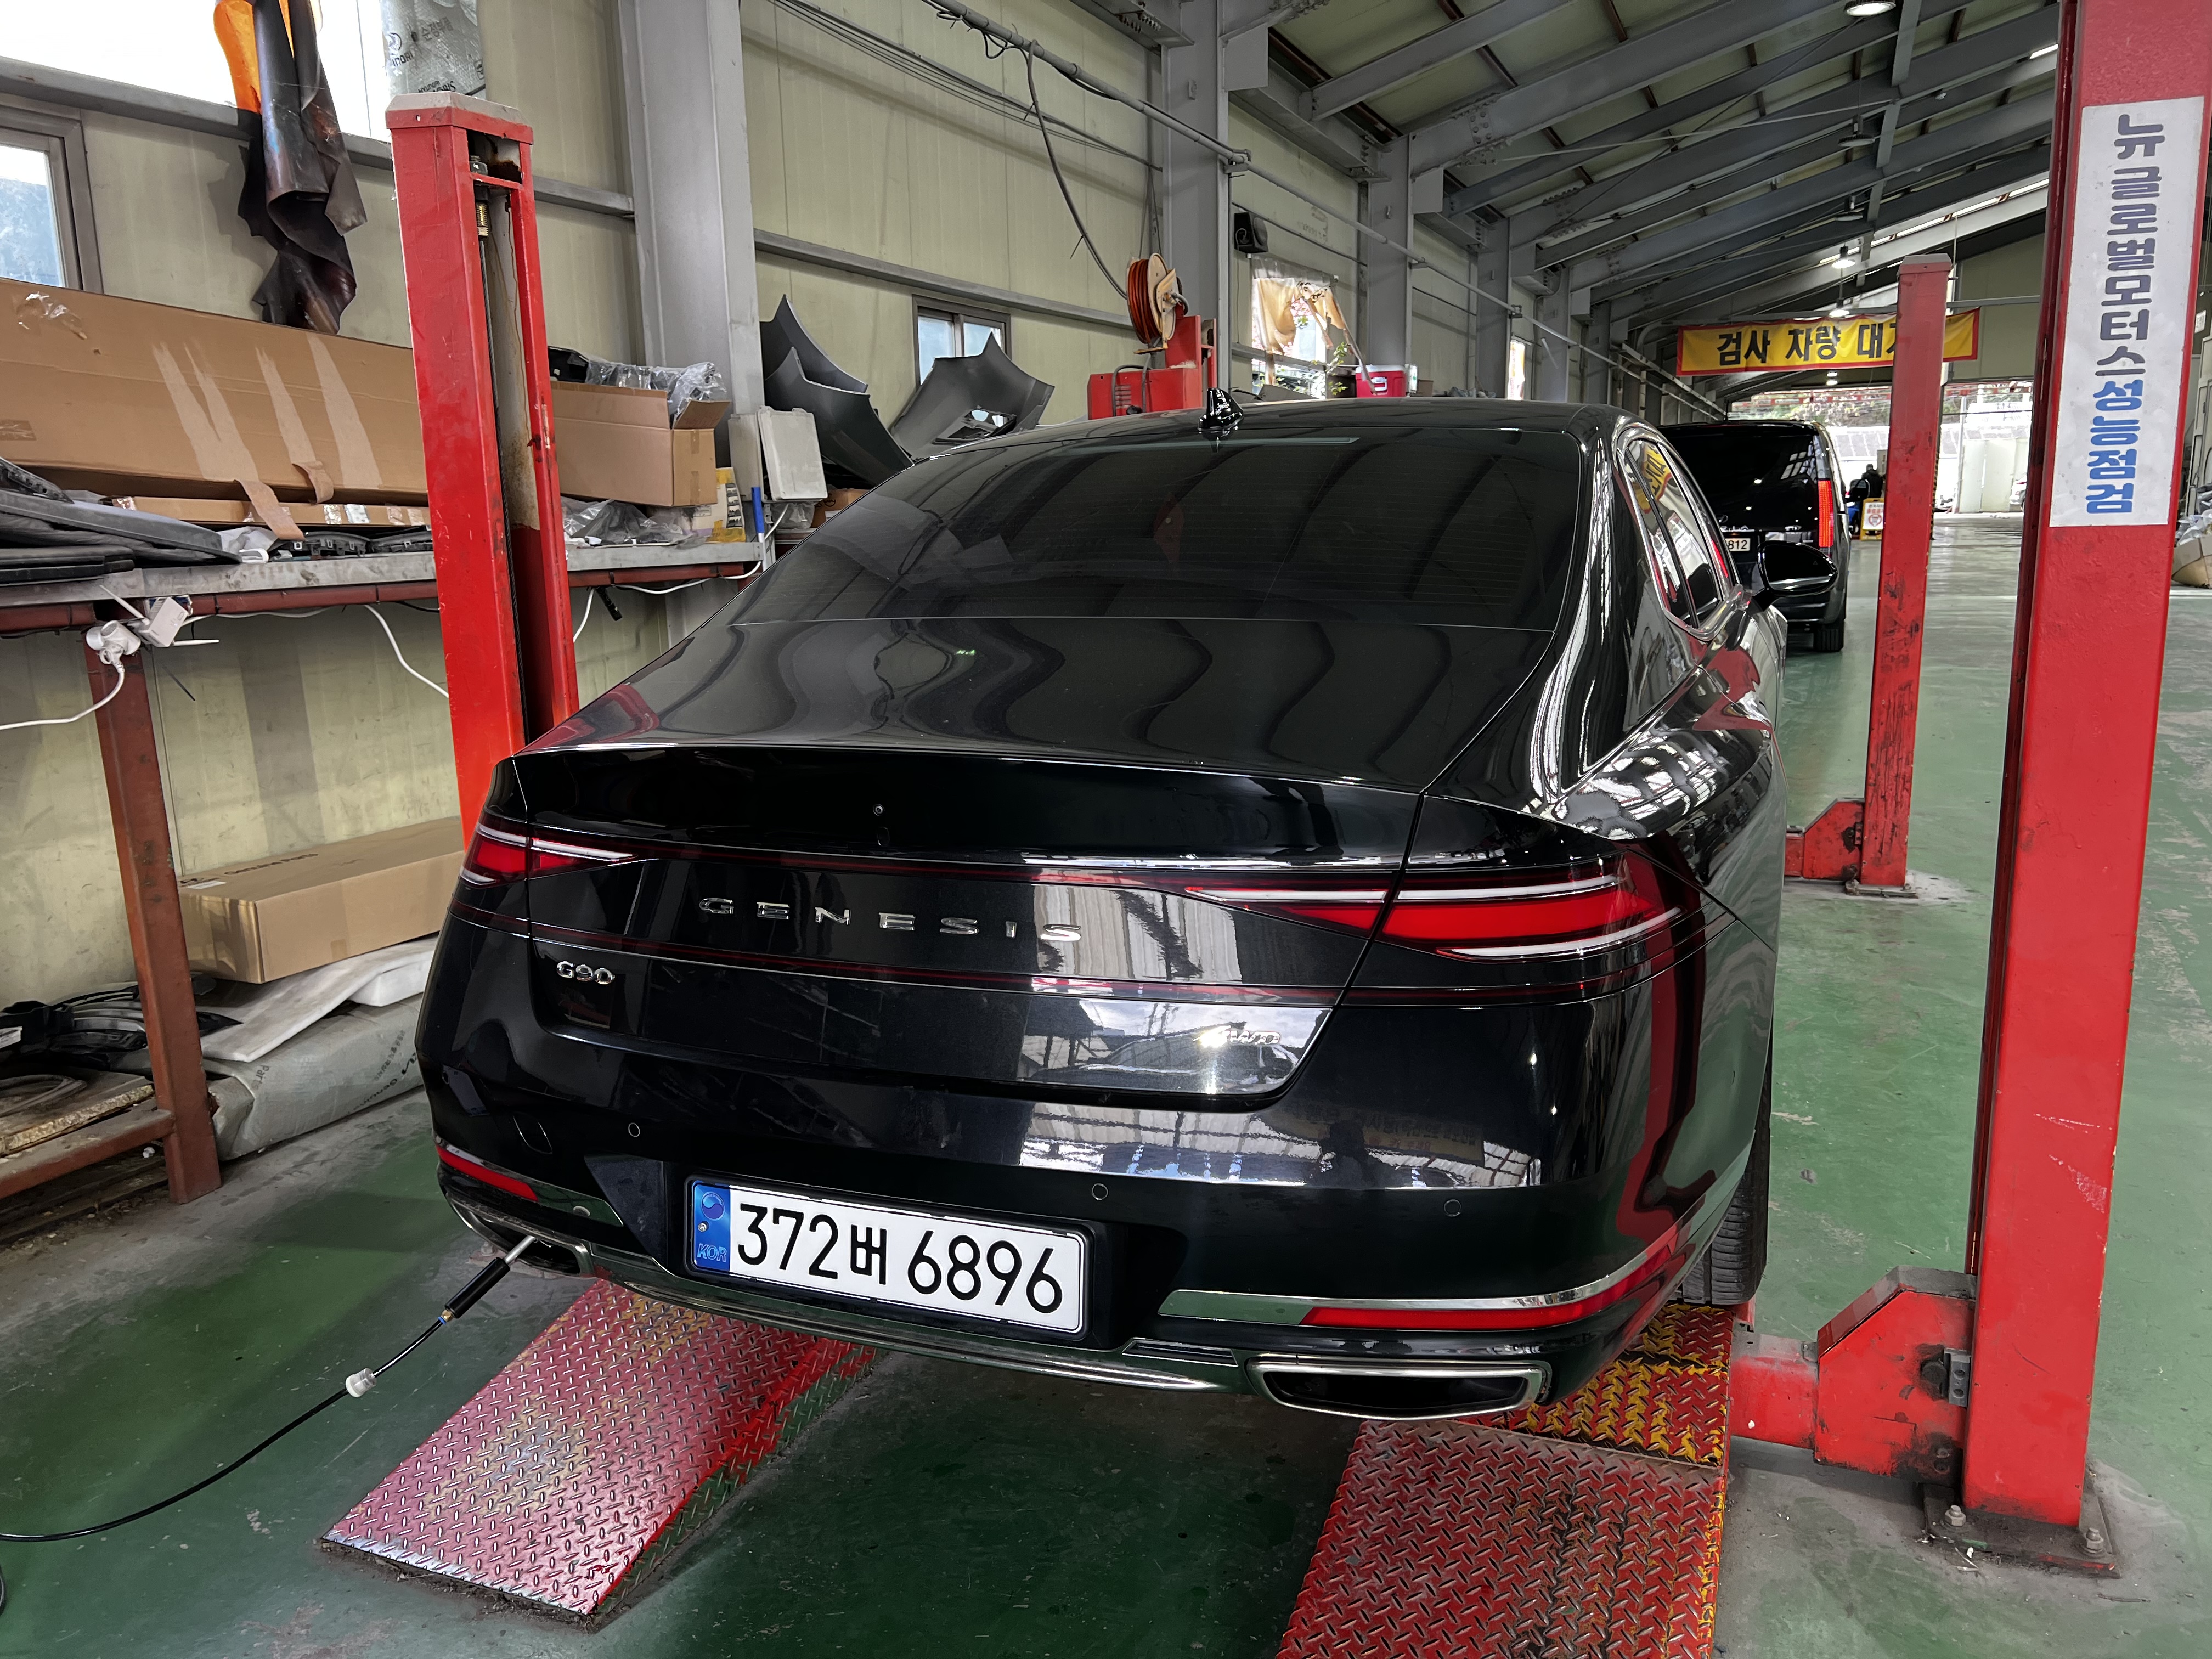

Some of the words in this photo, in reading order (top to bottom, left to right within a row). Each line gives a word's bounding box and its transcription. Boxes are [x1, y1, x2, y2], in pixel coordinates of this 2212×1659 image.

[433, 81, 456, 92] OBIS
[1717, 329, 1770, 366] 검사
[1785, 326, 1841, 361] 차량
[1857, 321, 1896, 359] 대
[1726, 539, 1747, 550] 812
[699, 897, 1082, 941] GENESIS
[556, 961, 615, 985] G90
[697, 1243, 727, 1262] KOR
[738, 1203, 887, 1285] 372버
[907, 1230, 1063, 1313] 6896
